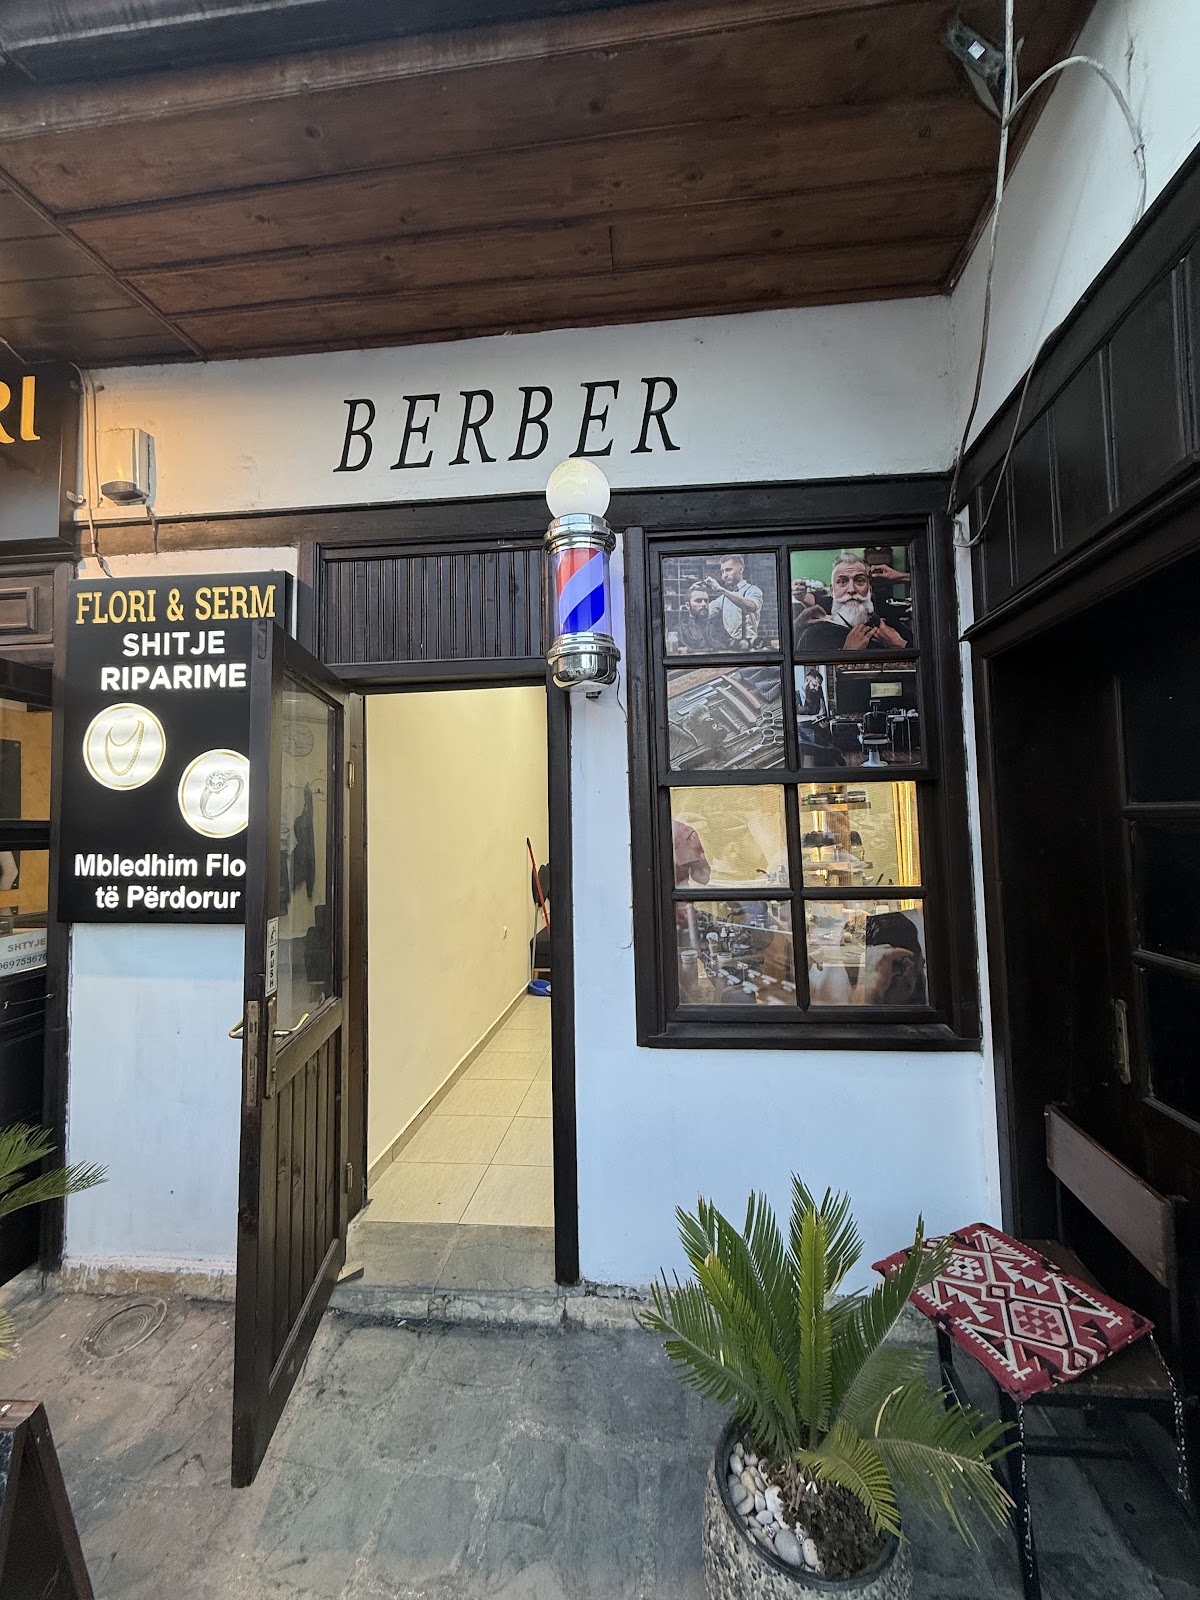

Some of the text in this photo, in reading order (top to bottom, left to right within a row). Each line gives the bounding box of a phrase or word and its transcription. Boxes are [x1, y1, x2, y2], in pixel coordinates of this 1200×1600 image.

[333, 377, 681, 472] BERBER
[76, 585, 276, 624] FLORI & SERM
[122, 630, 225, 657] SHITJE
[101, 663, 247, 691] RIPARIME
[74, 853, 247, 877] Mbledhim Flo
[95, 885, 241, 909] të Përdorur
[8, 938, 46, 952] SHTYJE
